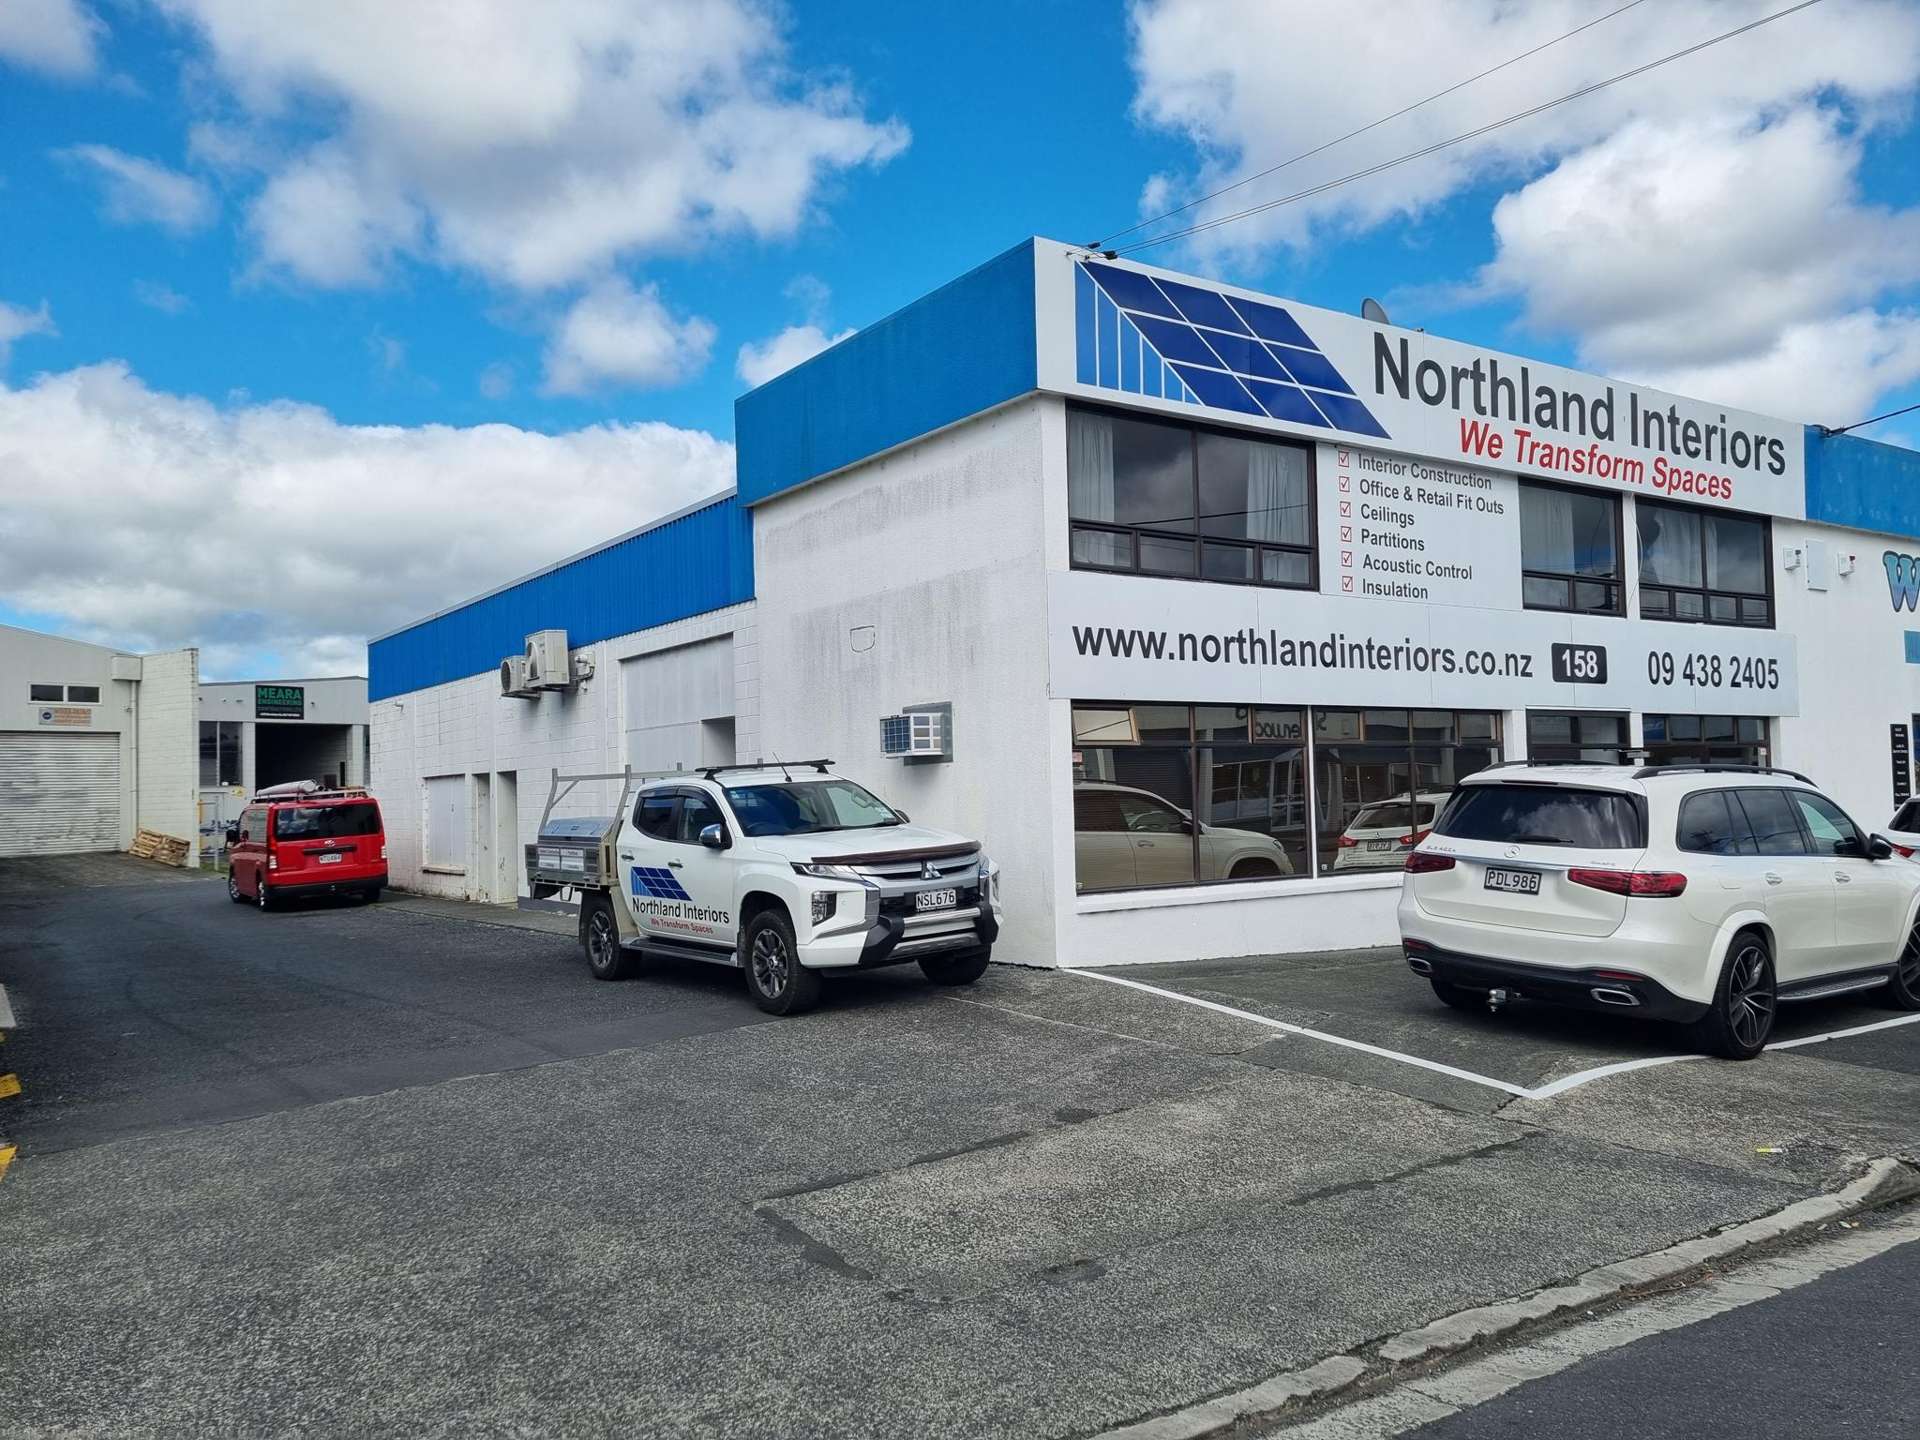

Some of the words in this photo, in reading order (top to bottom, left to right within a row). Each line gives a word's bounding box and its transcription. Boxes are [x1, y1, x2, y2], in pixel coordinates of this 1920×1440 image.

[1374, 331, 1615, 442] Northland
[1630, 392, 1786, 476] Interiors
[1358, 453, 1407, 476] Interior
[1410, 462, 1492, 490] Construction
[1460, 418, 1504, 460] We
[1514, 428, 1644, 485] Transform
[1652, 456, 1732, 500] Spaces
[1359, 478, 1400, 499] Office
[1403, 485, 1414, 502] &
[1417, 487, 1453, 508] Retail
[1456, 493, 1473, 511] Fit
[1476, 496, 1505, 515] Outs
[1360, 503, 1415, 529] Ceilings
[1361, 528, 1425, 551] Partitions
[1363, 553, 1422, 575] Acoustic
[1425, 560, 1473, 581] Control
[1362, 577, 1429, 600] Insulation
[1072, 625, 1534, 678] www.northlandinteriors.co.nz
[1561, 648, 1599, 679] 158
[1648, 650, 1675, 686] 09
[1682, 652, 1723, 688] 438
[1729, 655, 1780, 690] 2405
[257, 687, 302, 699] MEARA
[1487, 870, 1537, 890] PDL986
[632, 897, 681, 918] Northland
[684, 903, 730, 924] Interiors
[917, 891, 955, 907] NSL676
